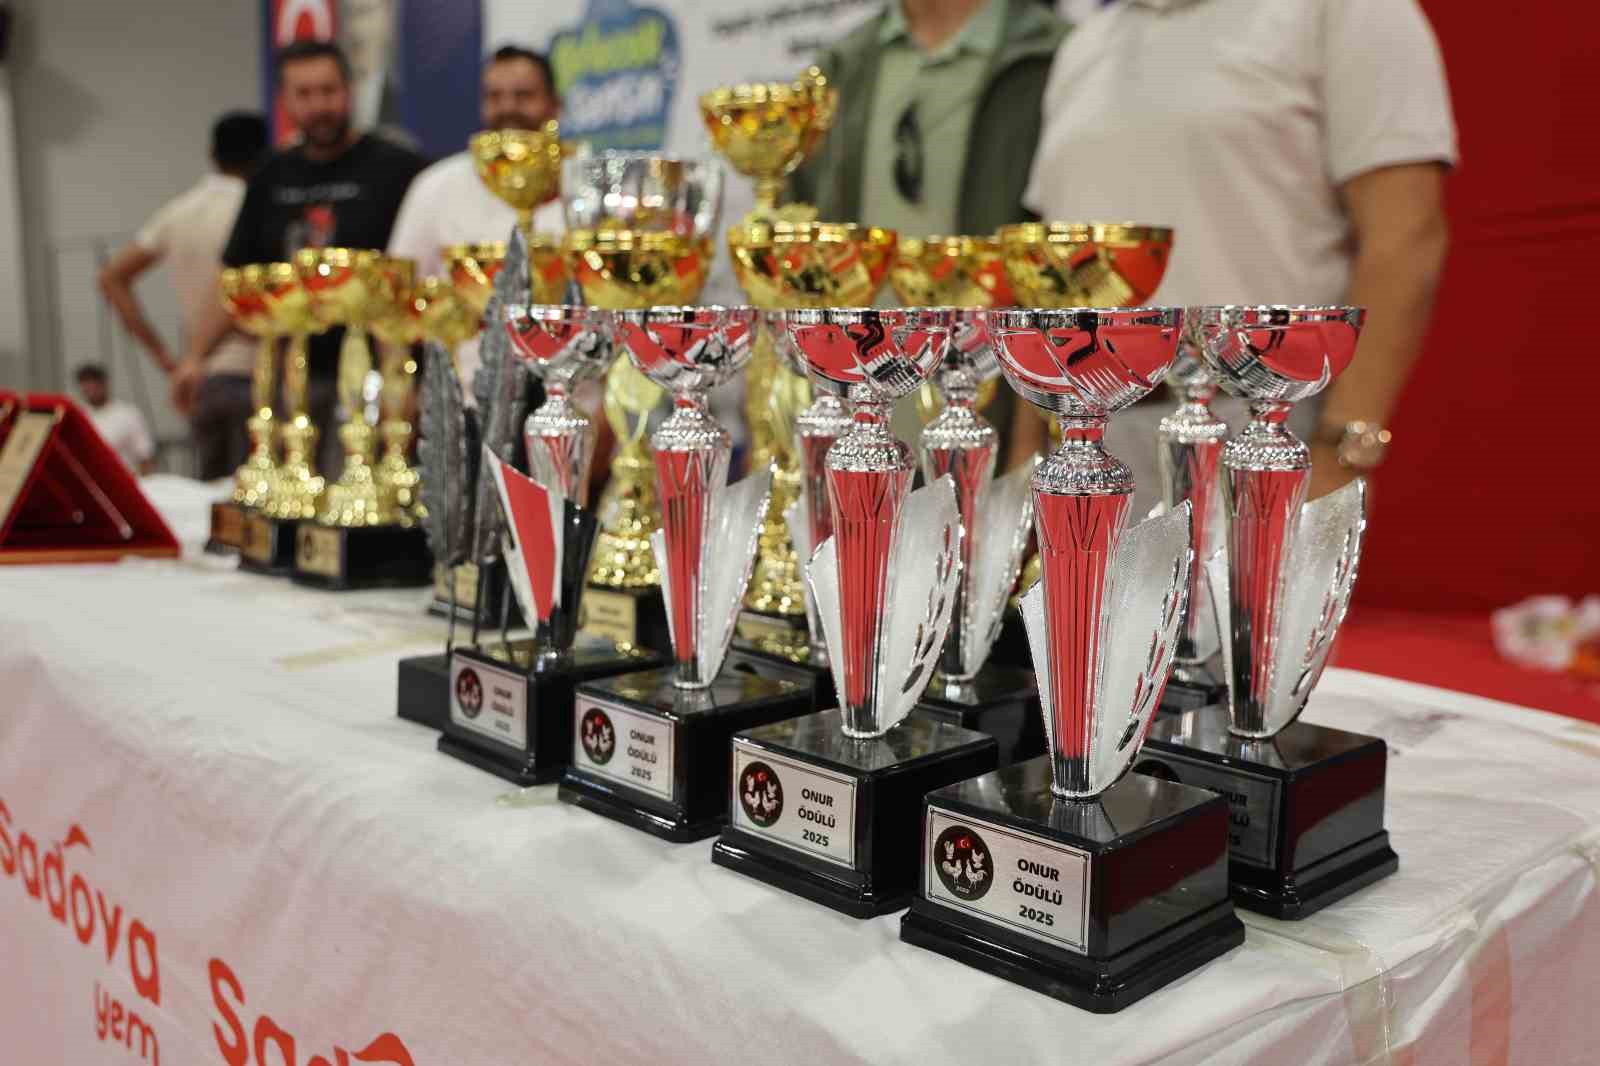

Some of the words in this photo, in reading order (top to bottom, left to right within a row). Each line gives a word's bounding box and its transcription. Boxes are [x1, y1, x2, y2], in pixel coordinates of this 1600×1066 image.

[629, 729, 655, 746] ONUR
[631, 765, 652, 781] 2025
[801, 788, 834, 808] ONUR
[797, 805, 836, 829] ÖDÜLÜ
[802, 828, 830, 847] 2025
[1017, 858, 1060, 882] ONUR
[1012, 877, 1063, 906] ÖDÜLÜ
[1019, 904, 1055, 926] 2025
[94, 980, 160, 1066] yem
